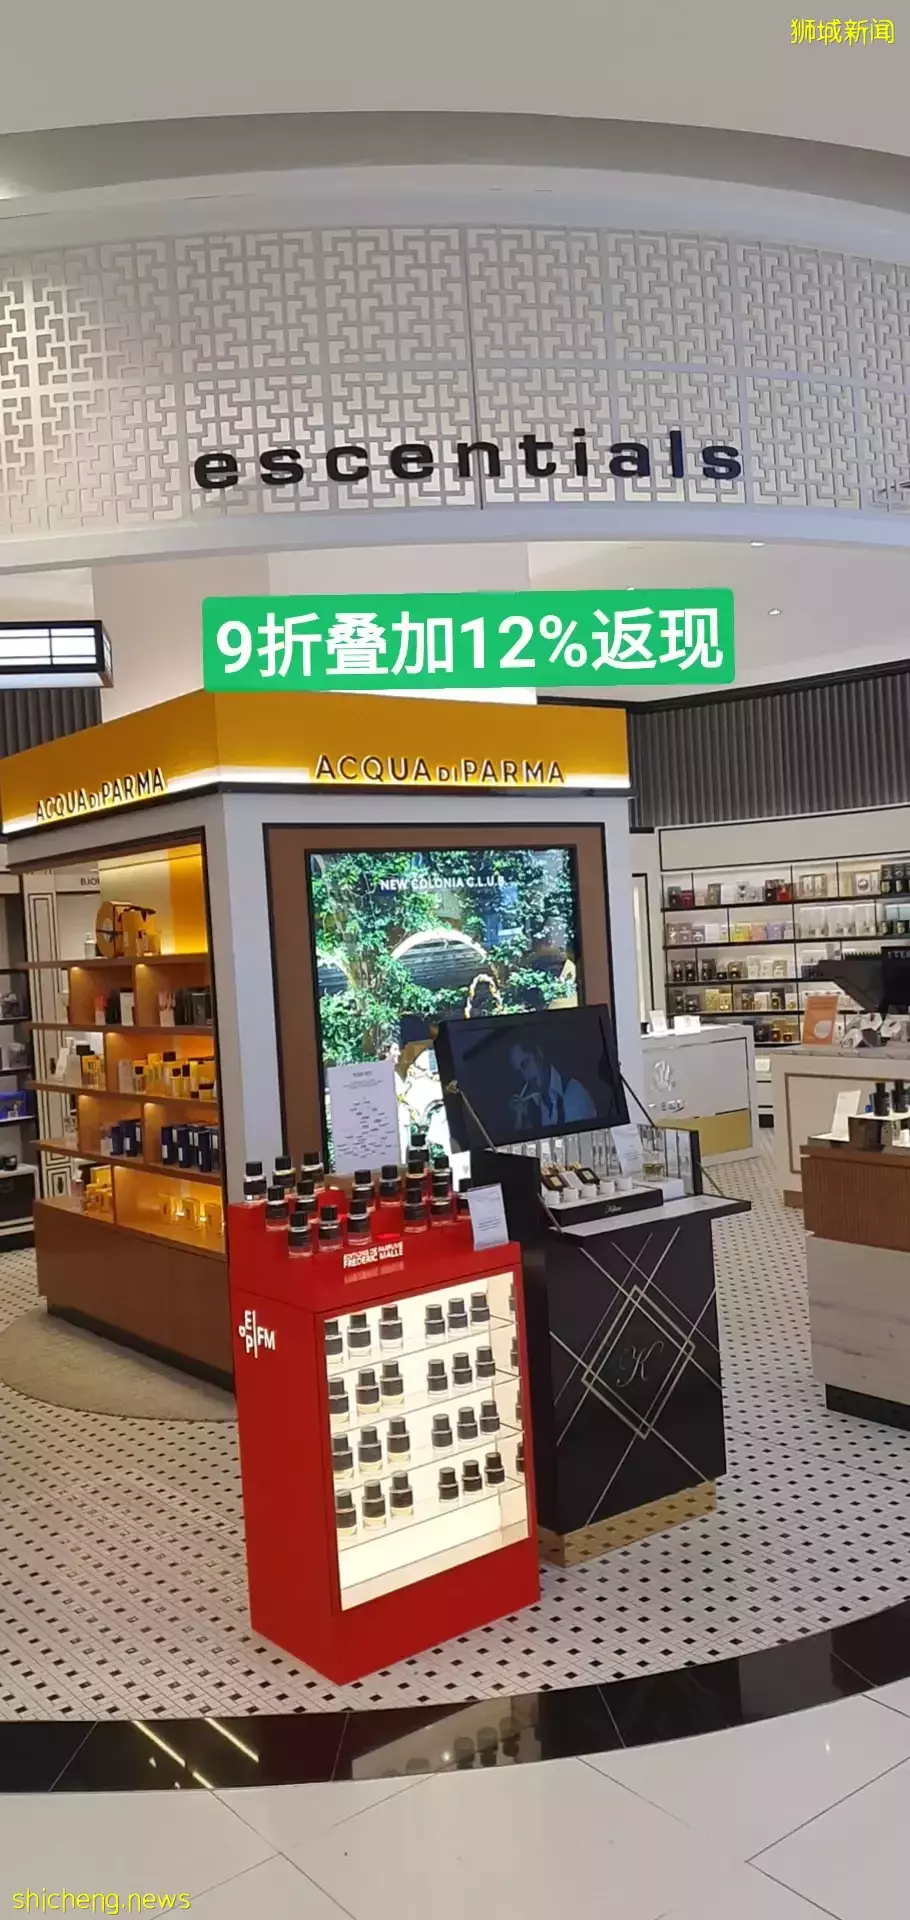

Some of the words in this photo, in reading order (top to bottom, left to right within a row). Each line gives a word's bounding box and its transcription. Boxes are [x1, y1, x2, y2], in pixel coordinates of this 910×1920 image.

[193, 427, 743, 490] escentials
[316, 754, 432, 782] ACQUA
[437, 766, 459, 782] DI
[460, 759, 565, 784] PARMA
[36, 788, 87, 823] ACQUA
[101, 767, 165, 806] PARMA
[380, 879, 408, 891] NEW
[411, 876, 464, 889] COLONIA
